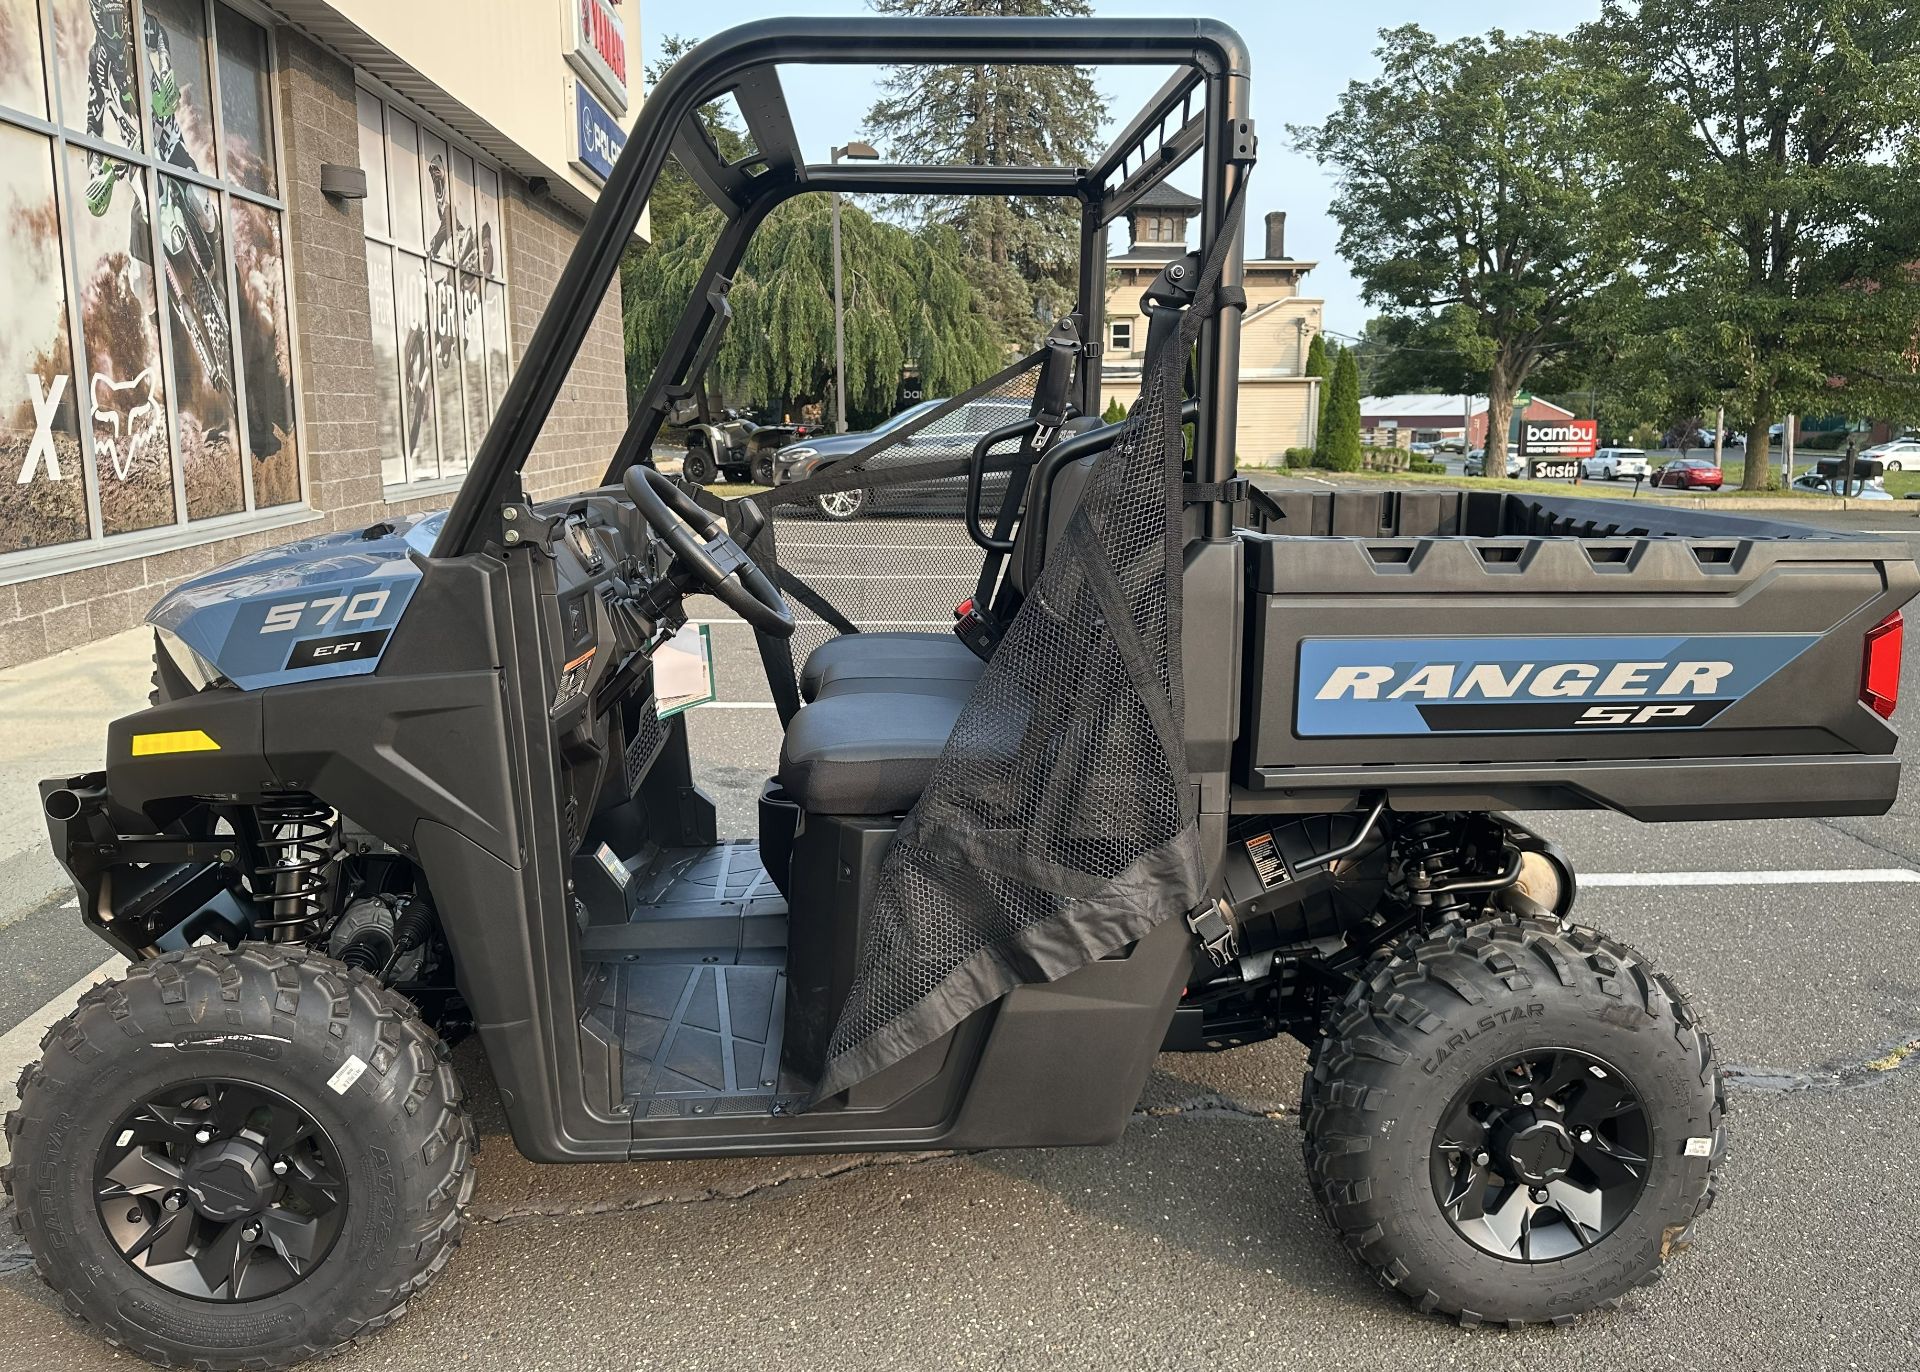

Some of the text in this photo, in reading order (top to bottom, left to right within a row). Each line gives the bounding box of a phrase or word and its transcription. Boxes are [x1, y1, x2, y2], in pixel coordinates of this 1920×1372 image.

[17, 373, 69, 484] X
[1527, 425, 1593, 441] bambu
[1535, 462, 1579, 478] Sushi
[259, 590, 391, 634] 570
[312, 641, 362, 657] EFI
[1315, 661, 1734, 700] RANGER
[1573, 705, 1697, 725] SP
[1421, 1003, 1545, 1076] CARLSTAR
[39, 1111, 75, 1249] CARLSTAR
